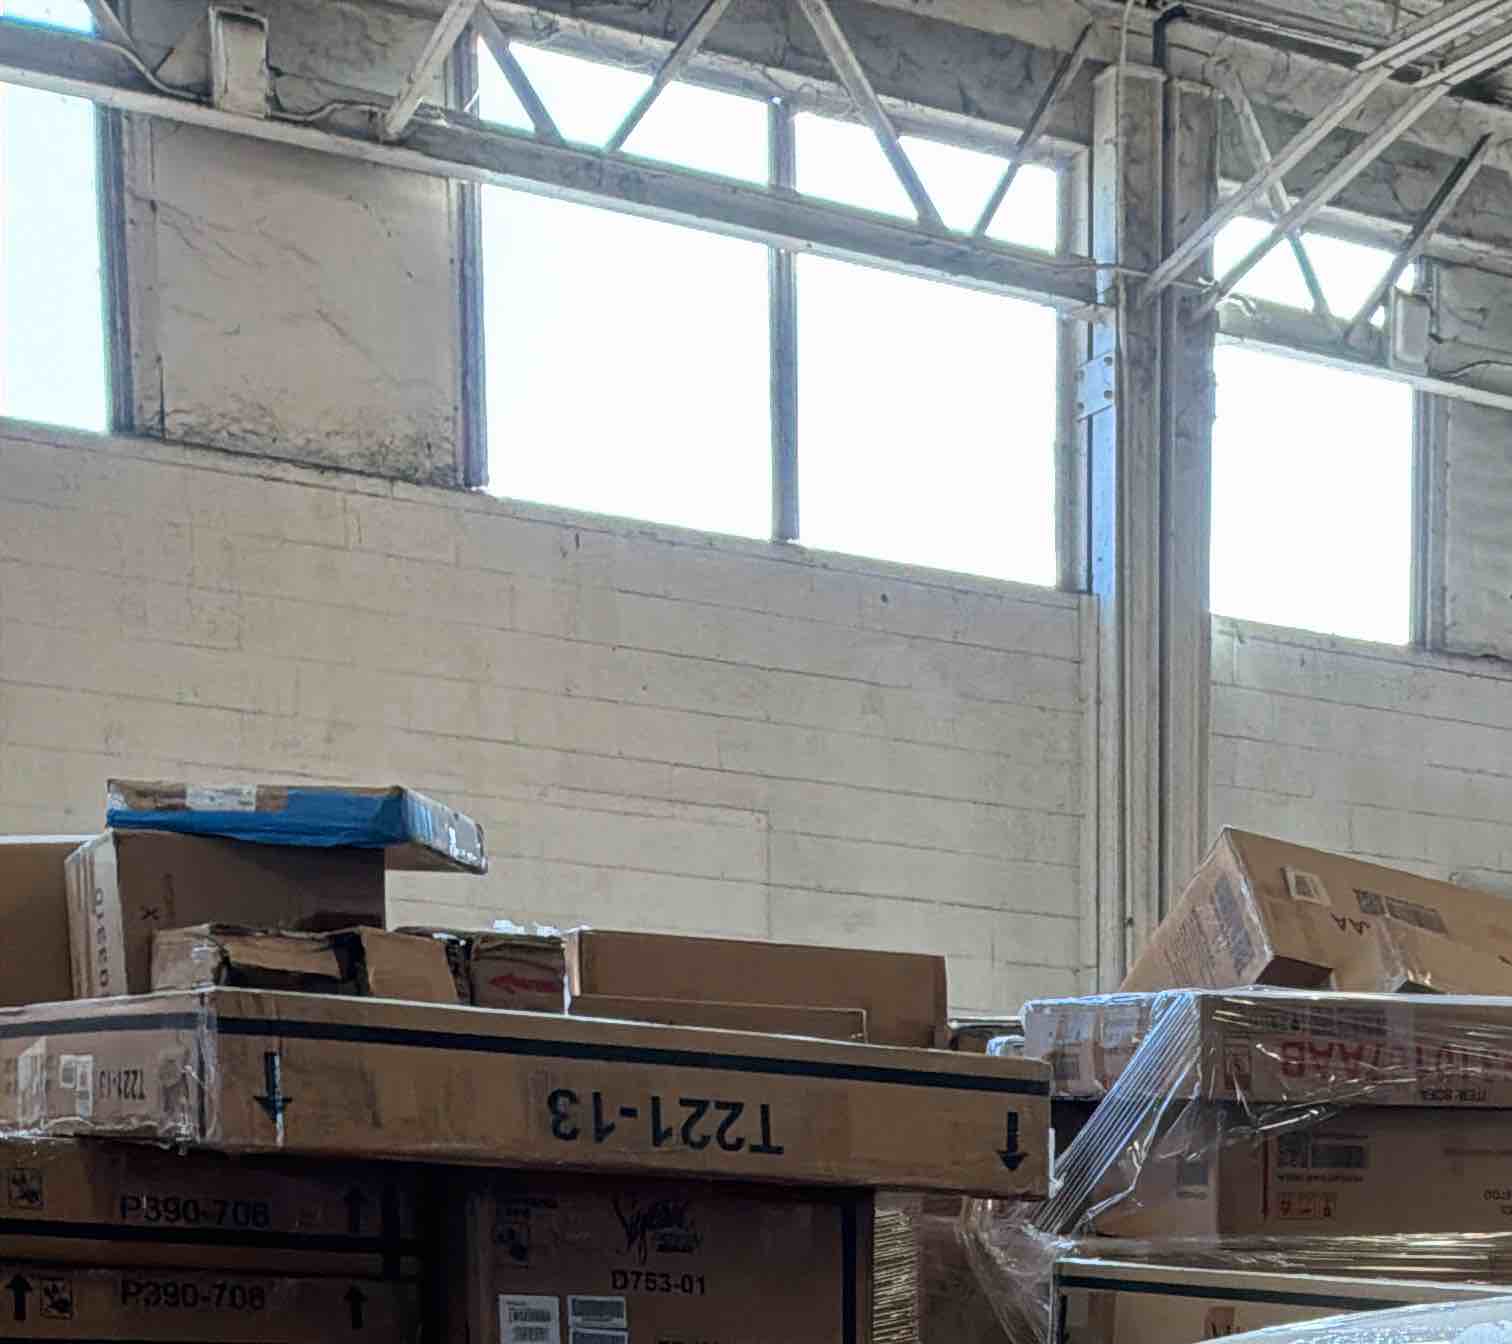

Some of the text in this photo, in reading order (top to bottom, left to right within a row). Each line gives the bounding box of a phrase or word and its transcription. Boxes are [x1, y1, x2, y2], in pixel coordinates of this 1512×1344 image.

[547, 1087, 785, 1156] T221-13
[119, 1278, 268, 1313] P390-708
[610, 1269, 707, 1297] D753-01
